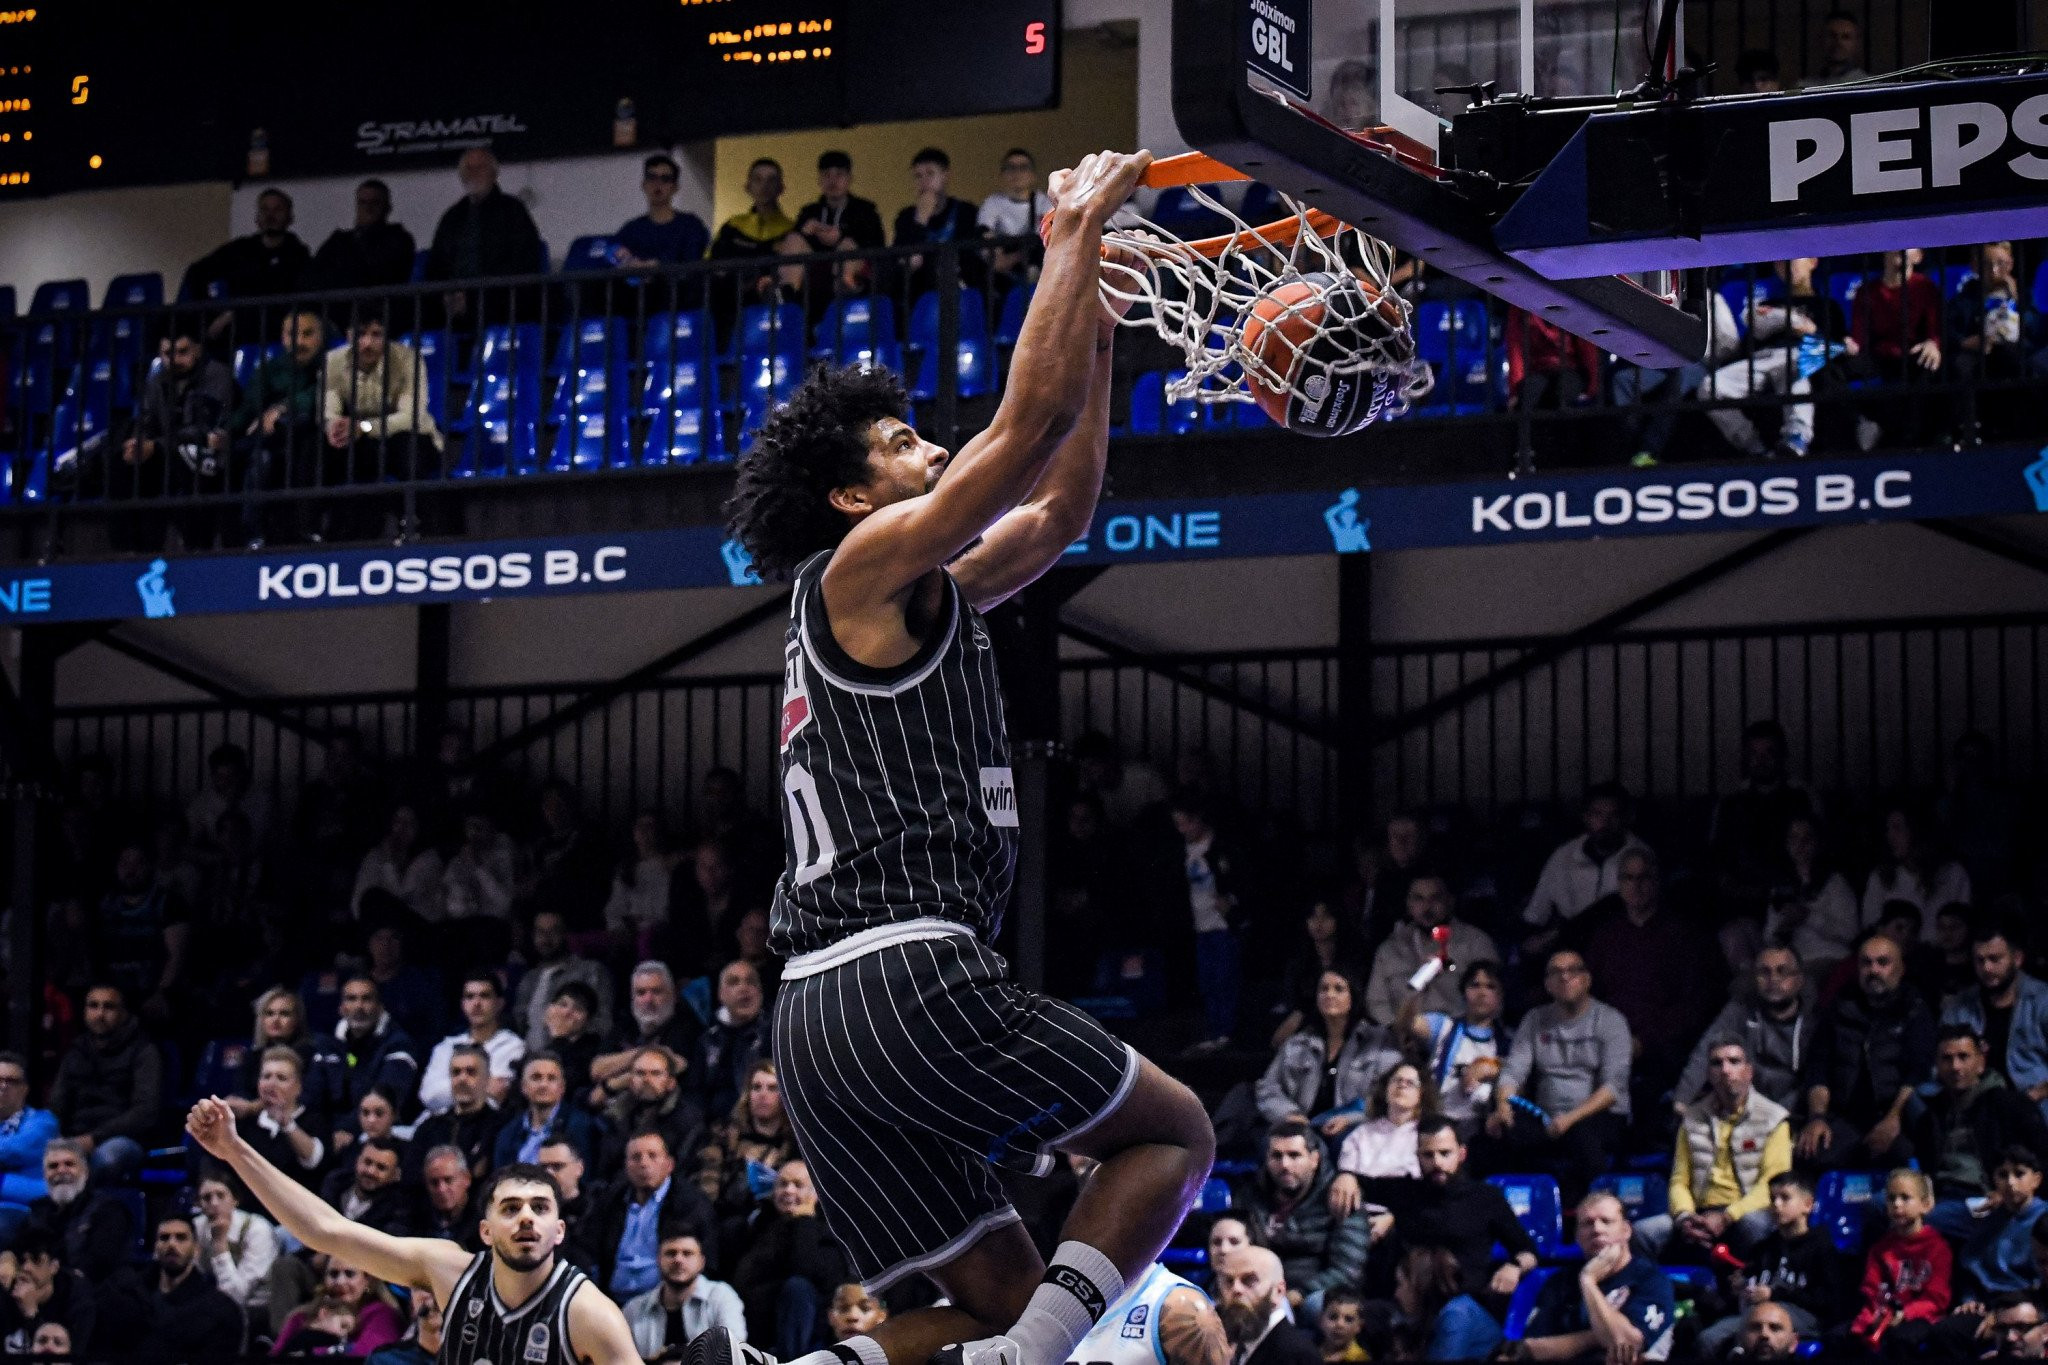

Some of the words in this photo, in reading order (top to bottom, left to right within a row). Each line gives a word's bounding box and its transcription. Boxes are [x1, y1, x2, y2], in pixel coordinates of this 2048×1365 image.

[1252, 17, 1293, 72] GBL
[356, 114, 527, 149] STRAMATEL
[1472, 477, 1799, 533] KOLOSSOS
[1815, 470, 1911, 512] B.C
[1105, 511, 1221, 551] ONE
[258, 552, 532, 601] KOLOSSOS
[544, 545, 627, 585] B.C
[1056, 1270, 1103, 1320] GSA
